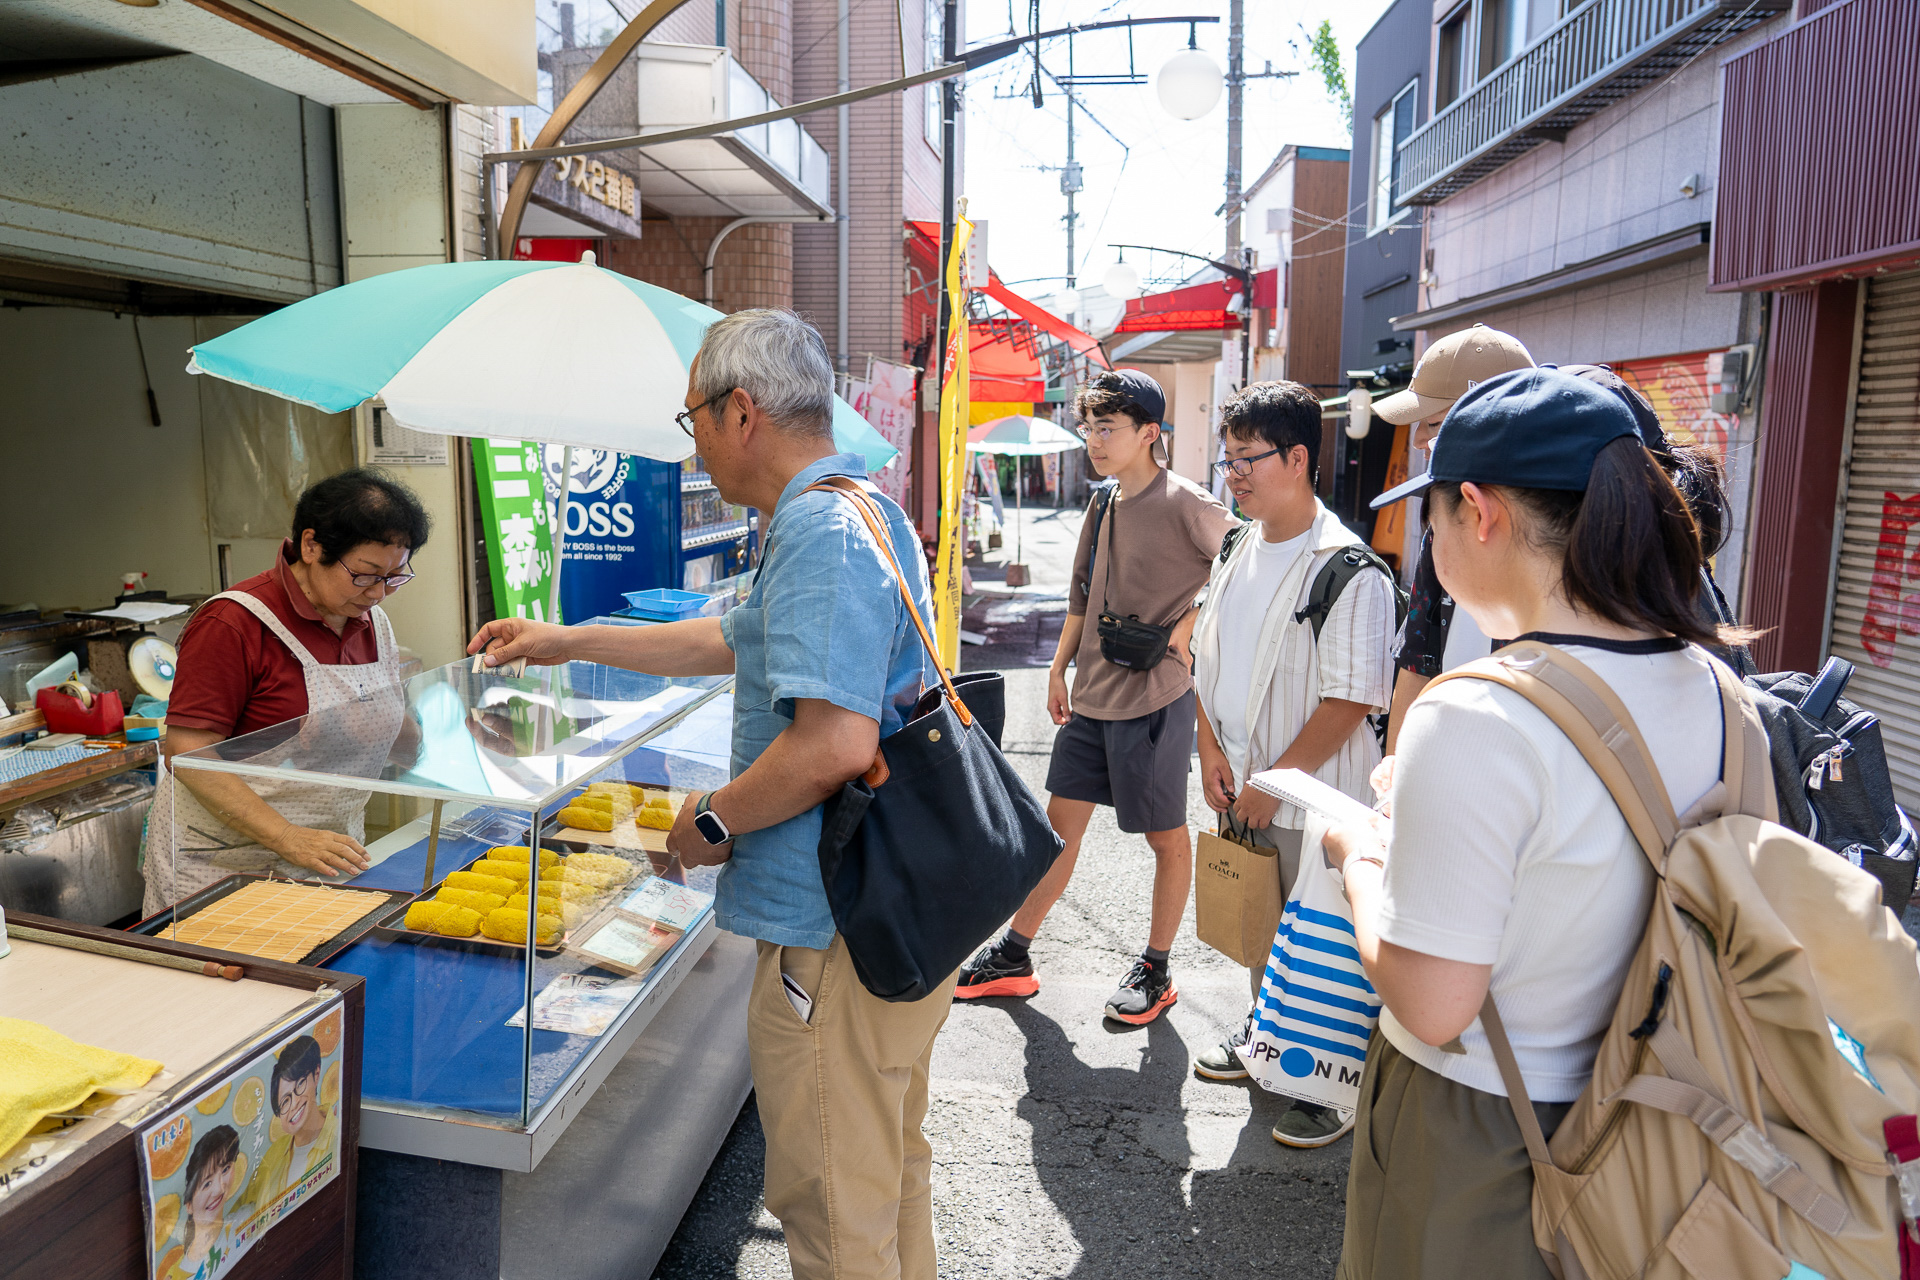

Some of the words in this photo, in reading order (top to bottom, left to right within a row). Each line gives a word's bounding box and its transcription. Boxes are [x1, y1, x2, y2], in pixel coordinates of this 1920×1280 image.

[601, 462, 630, 501] COFFEE
[572, 542, 595, 551] BOSS
[596, 543, 603, 552] is
[604, 543, 616, 552] the
[617, 544, 635, 553] boss
[573, 552, 583, 560] all
[584, 552, 603, 561] since
[605, 553, 622, 562] 1992
[1208, 862, 1240, 880] COACH
[1338, 1065, 1361, 1088] M
